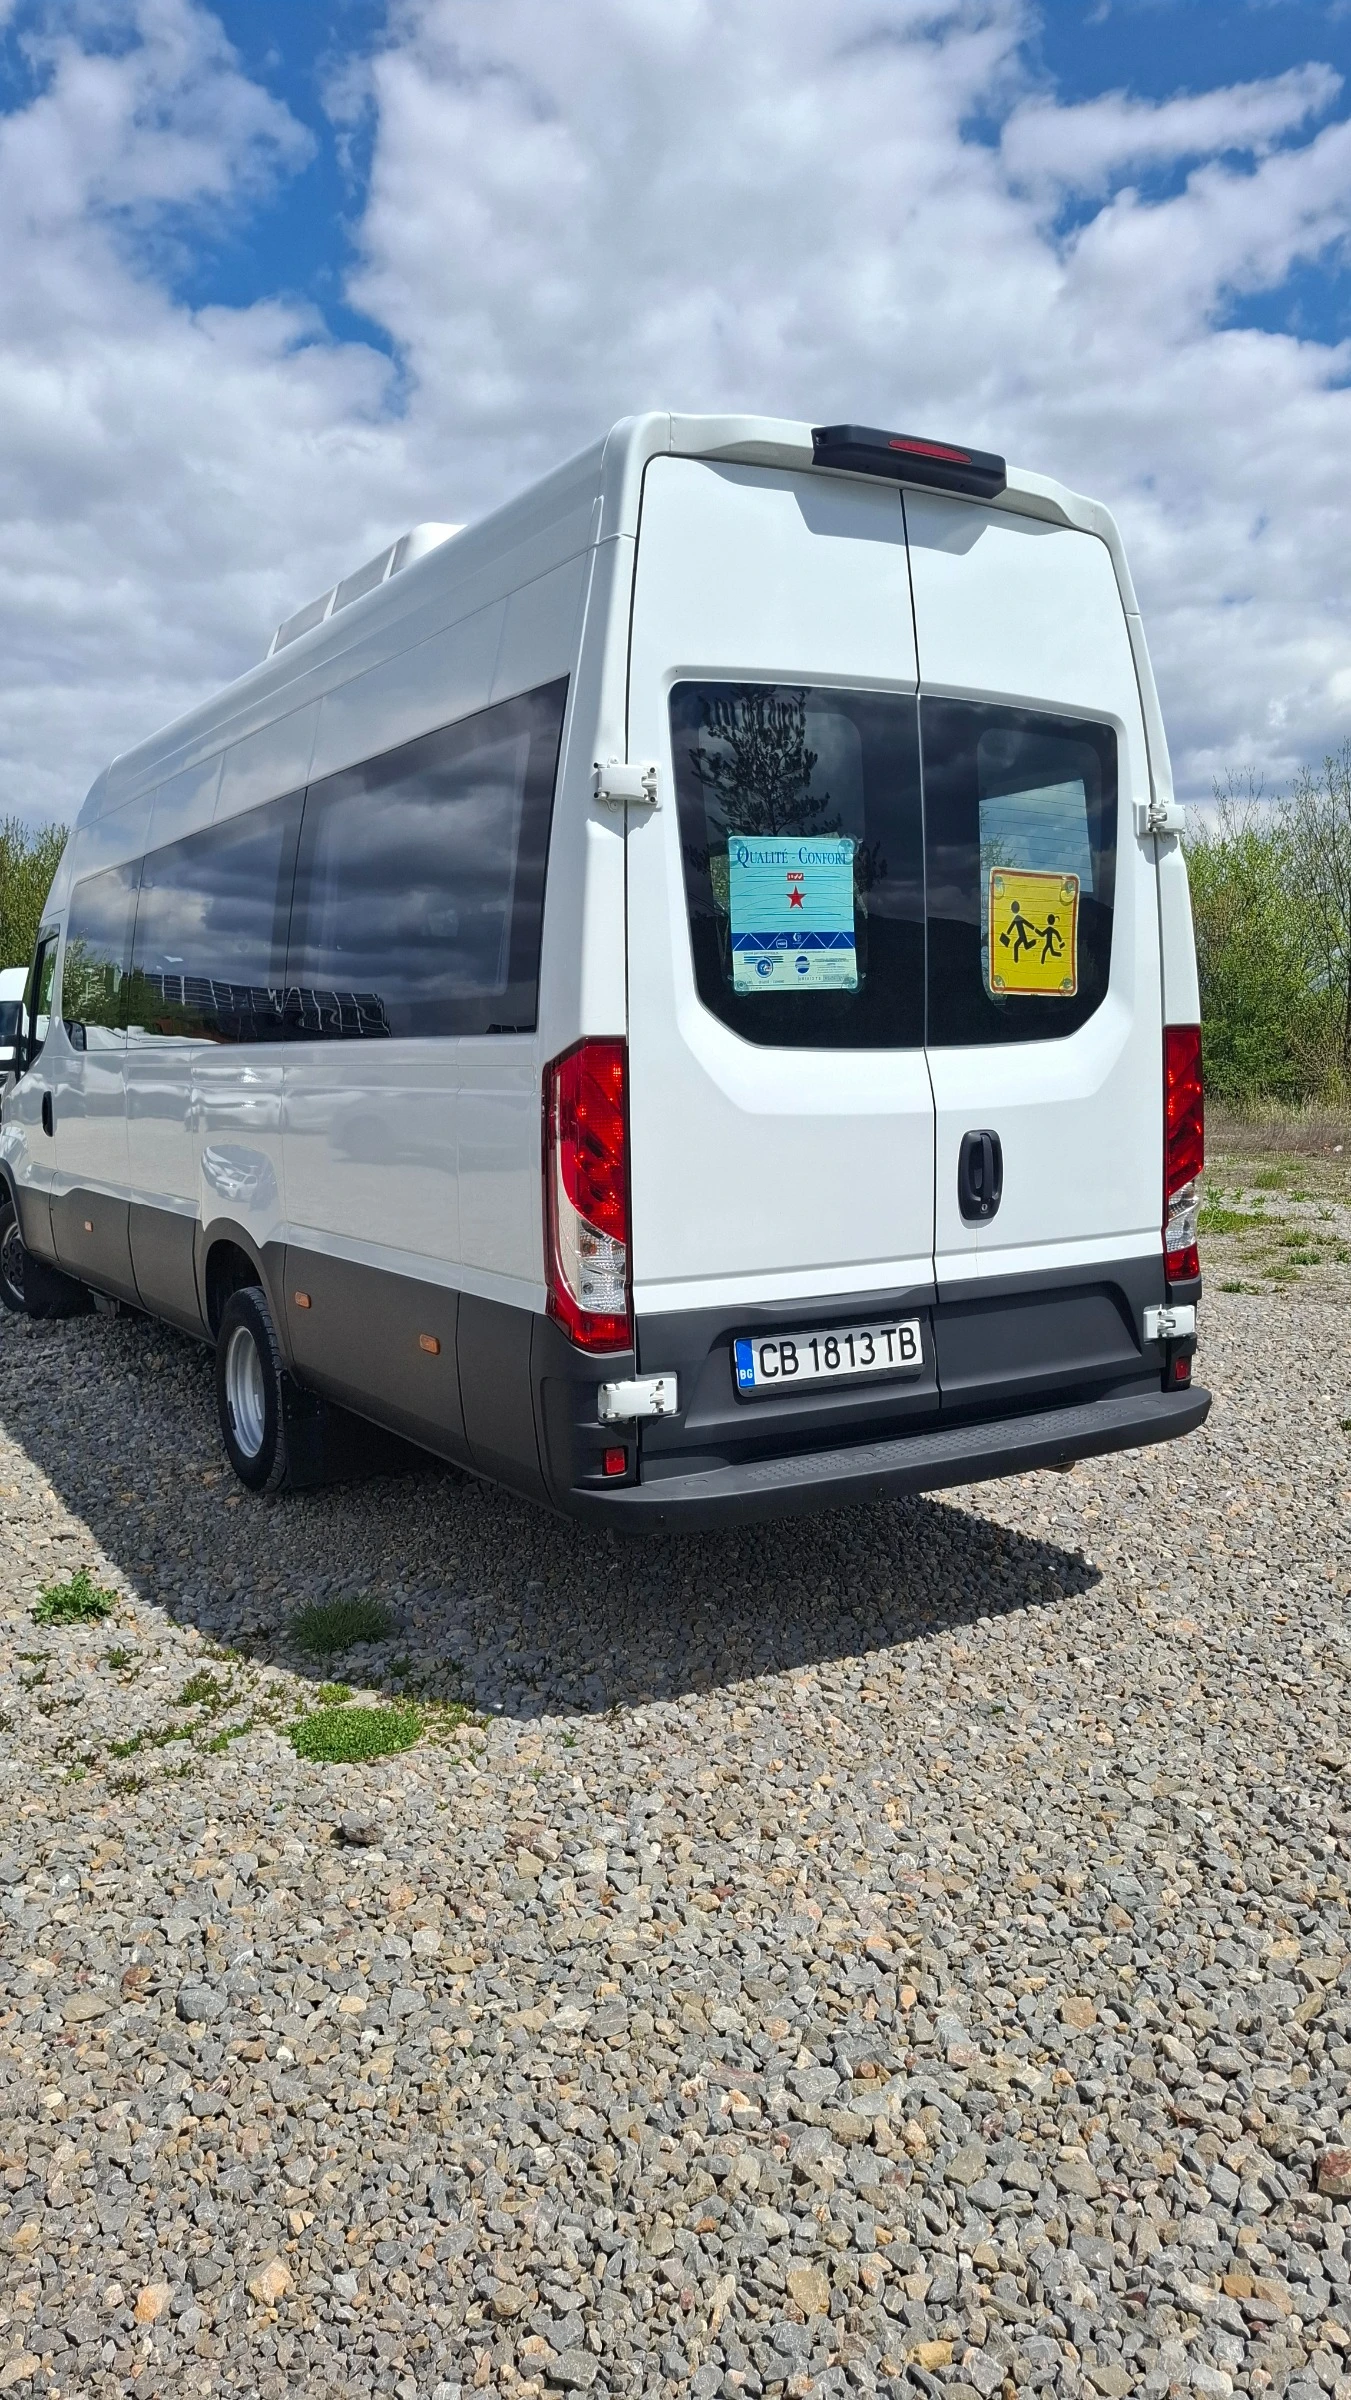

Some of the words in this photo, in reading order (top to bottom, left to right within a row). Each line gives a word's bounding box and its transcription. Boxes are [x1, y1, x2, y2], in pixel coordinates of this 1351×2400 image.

[759, 1341, 799, 1378] CB
[809, 1332, 876, 1372] 1813
[881, 1327, 917, 1362] TB
[740, 1368, 753, 1380] BG
